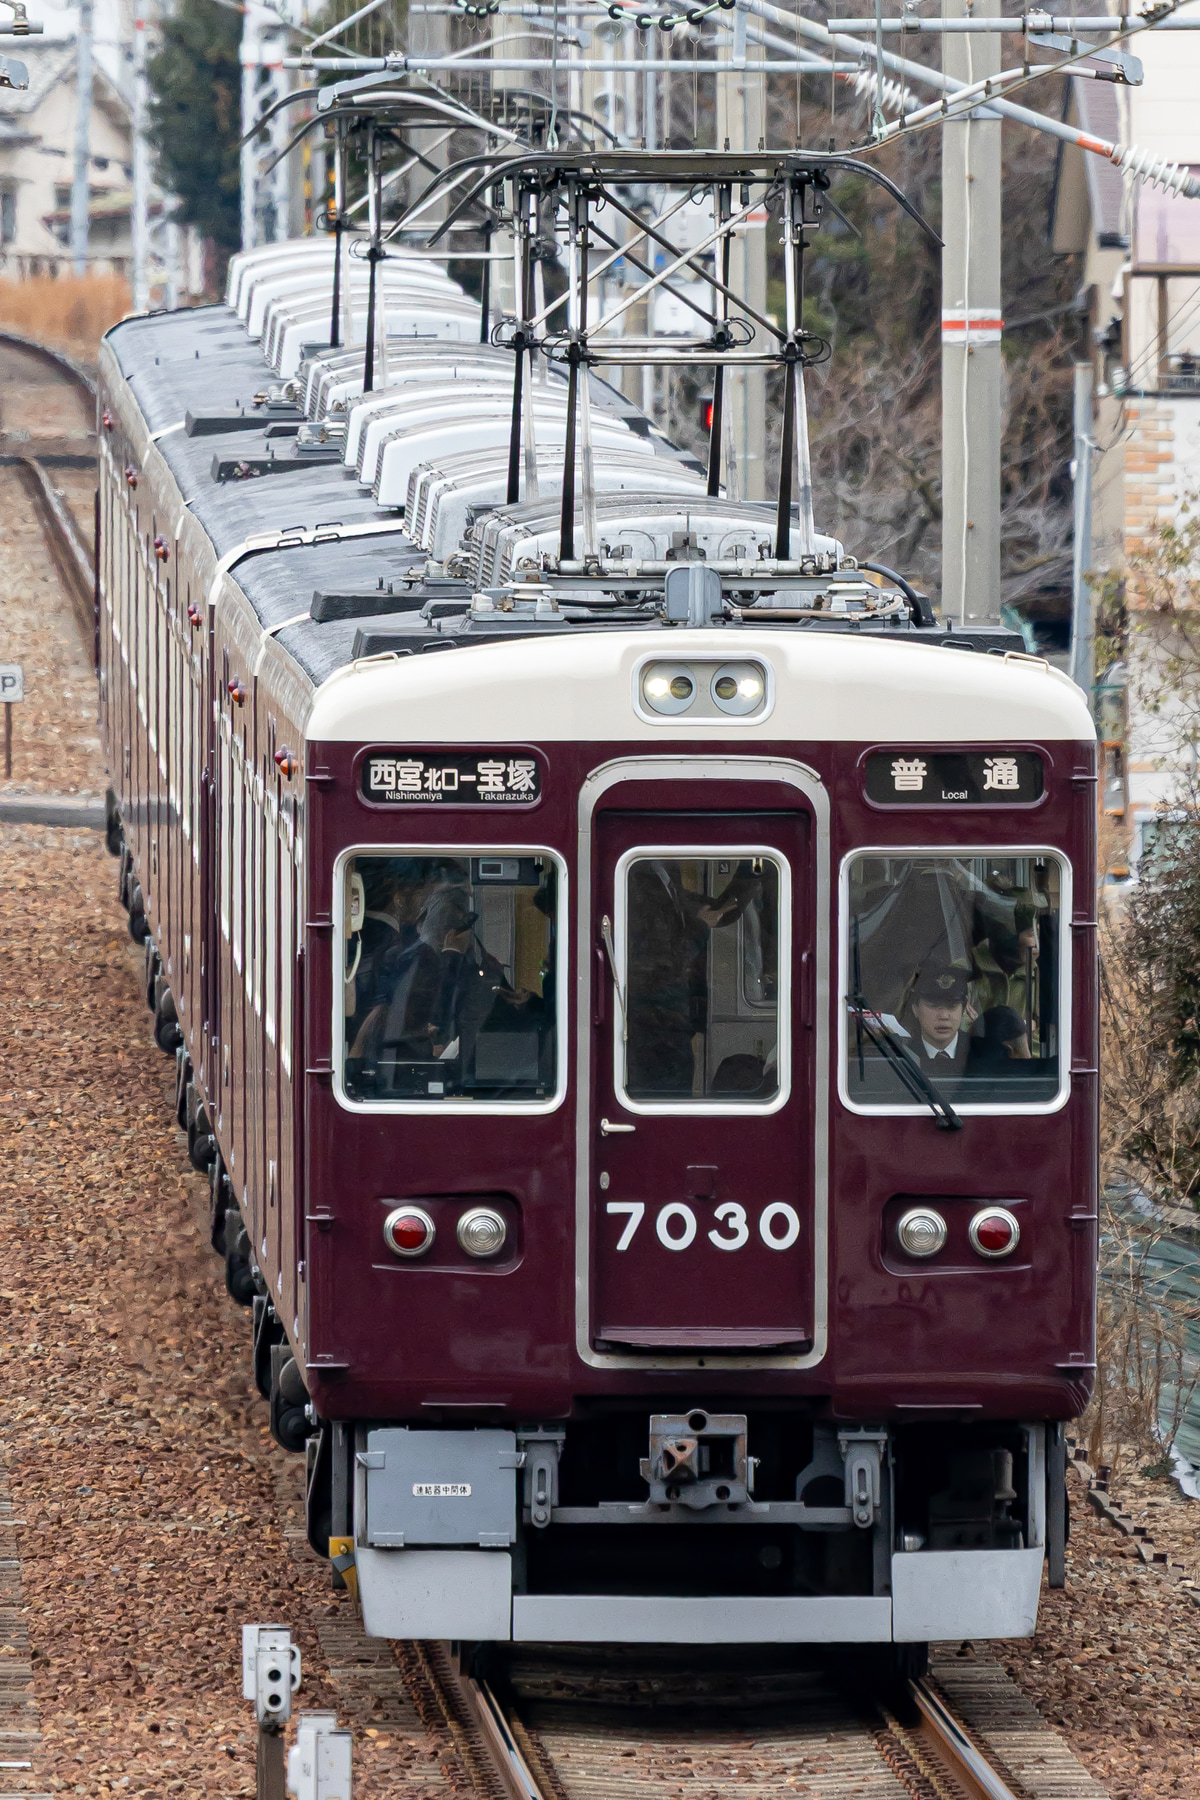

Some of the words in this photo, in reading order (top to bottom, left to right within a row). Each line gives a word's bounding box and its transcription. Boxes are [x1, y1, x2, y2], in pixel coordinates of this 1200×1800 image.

[1, 676, 16, 692] P
[385, 791, 443, 801] Nishinomiya
[479, 791, 534, 801] Takarazuka
[942, 790, 968, 800] Local
[606, 1202, 801, 1251] 7030
